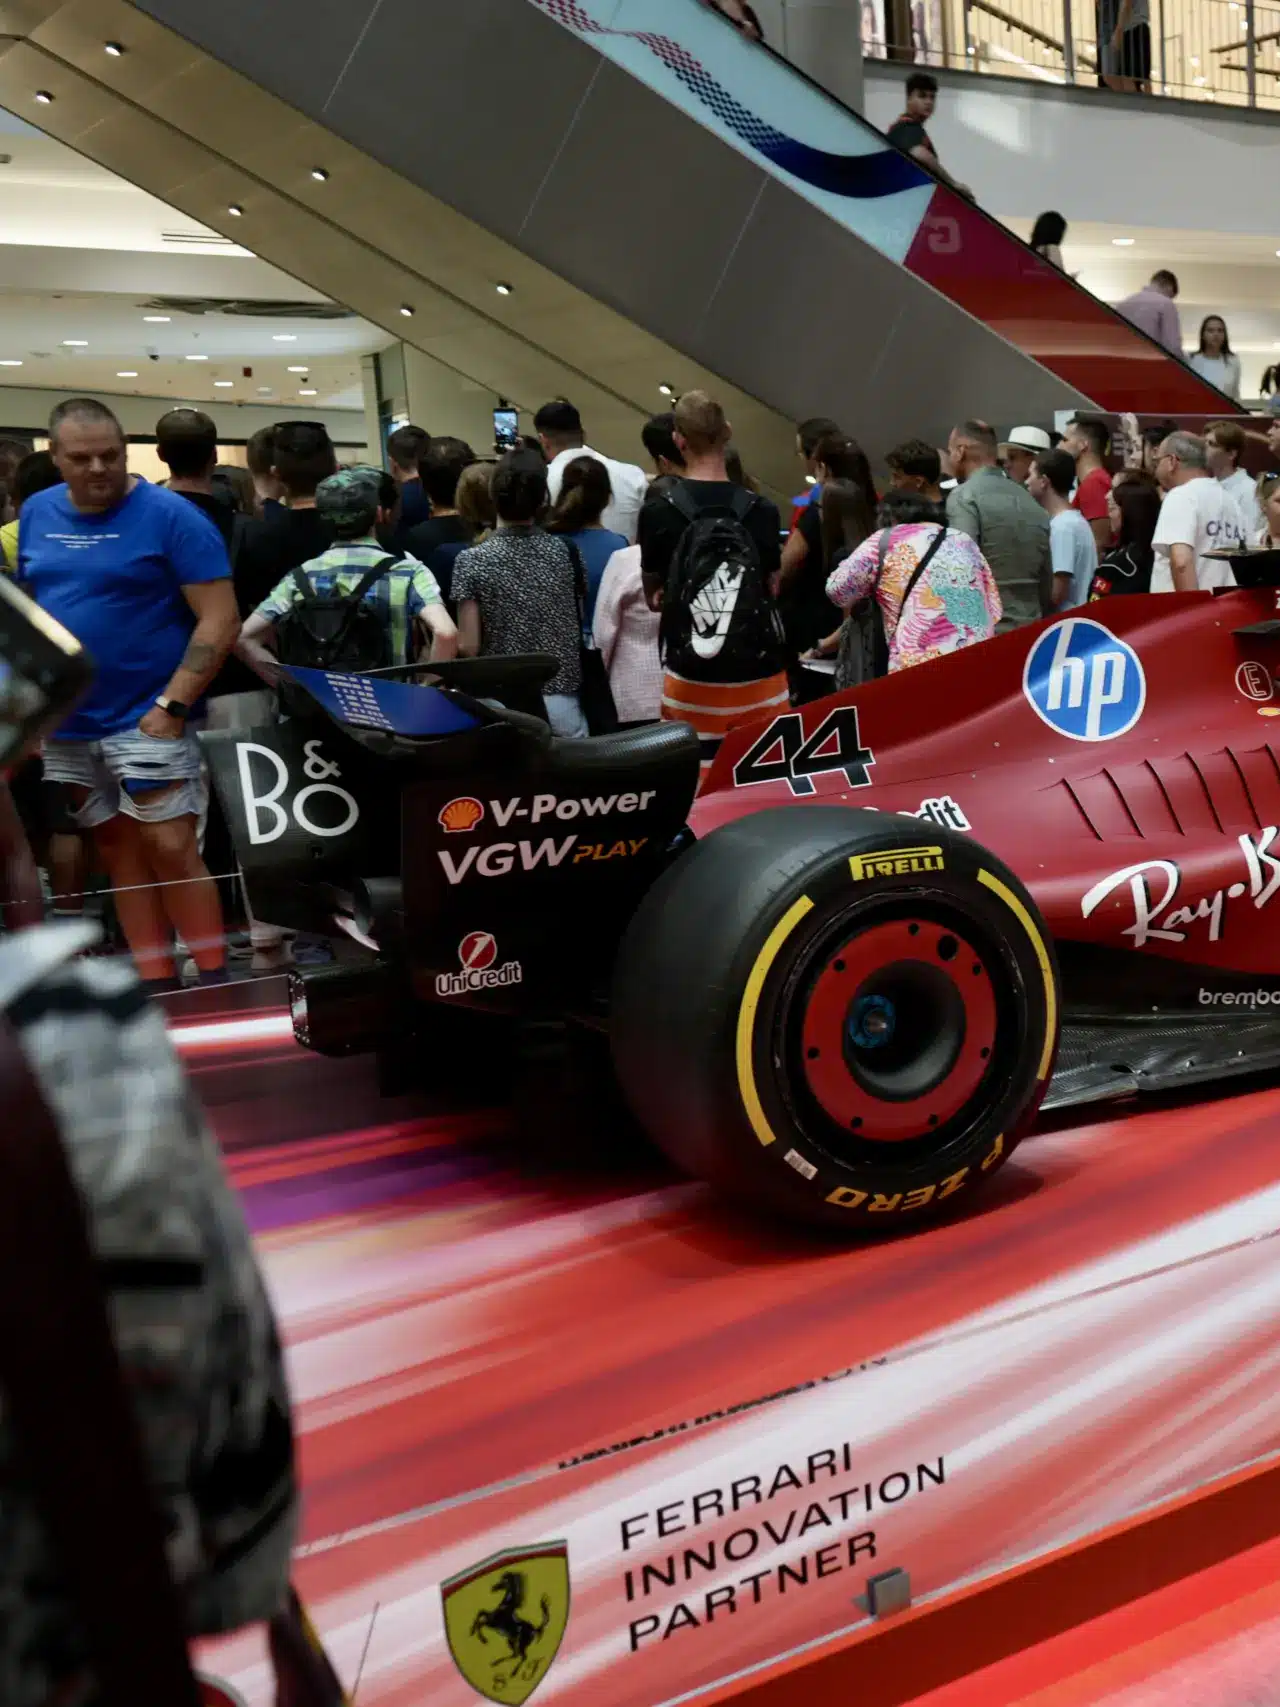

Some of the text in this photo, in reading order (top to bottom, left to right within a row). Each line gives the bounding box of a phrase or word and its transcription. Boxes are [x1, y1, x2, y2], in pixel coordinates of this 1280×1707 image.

[1044, 620, 1127, 739] hp
[732, 706, 877, 797] 44
[489, 789, 656, 828] V-Power
[436, 835, 648, 886] VGW PLAY
[848, 845, 945, 882] PIRELLI
[435, 961, 523, 997] UniCredit
[825, 1165, 971, 1213] ZERO
[619, 1442, 852, 1551] FERRARI
[622, 1456, 947, 1602] INNOVATION
[627, 1530, 878, 1652] PARTNER
